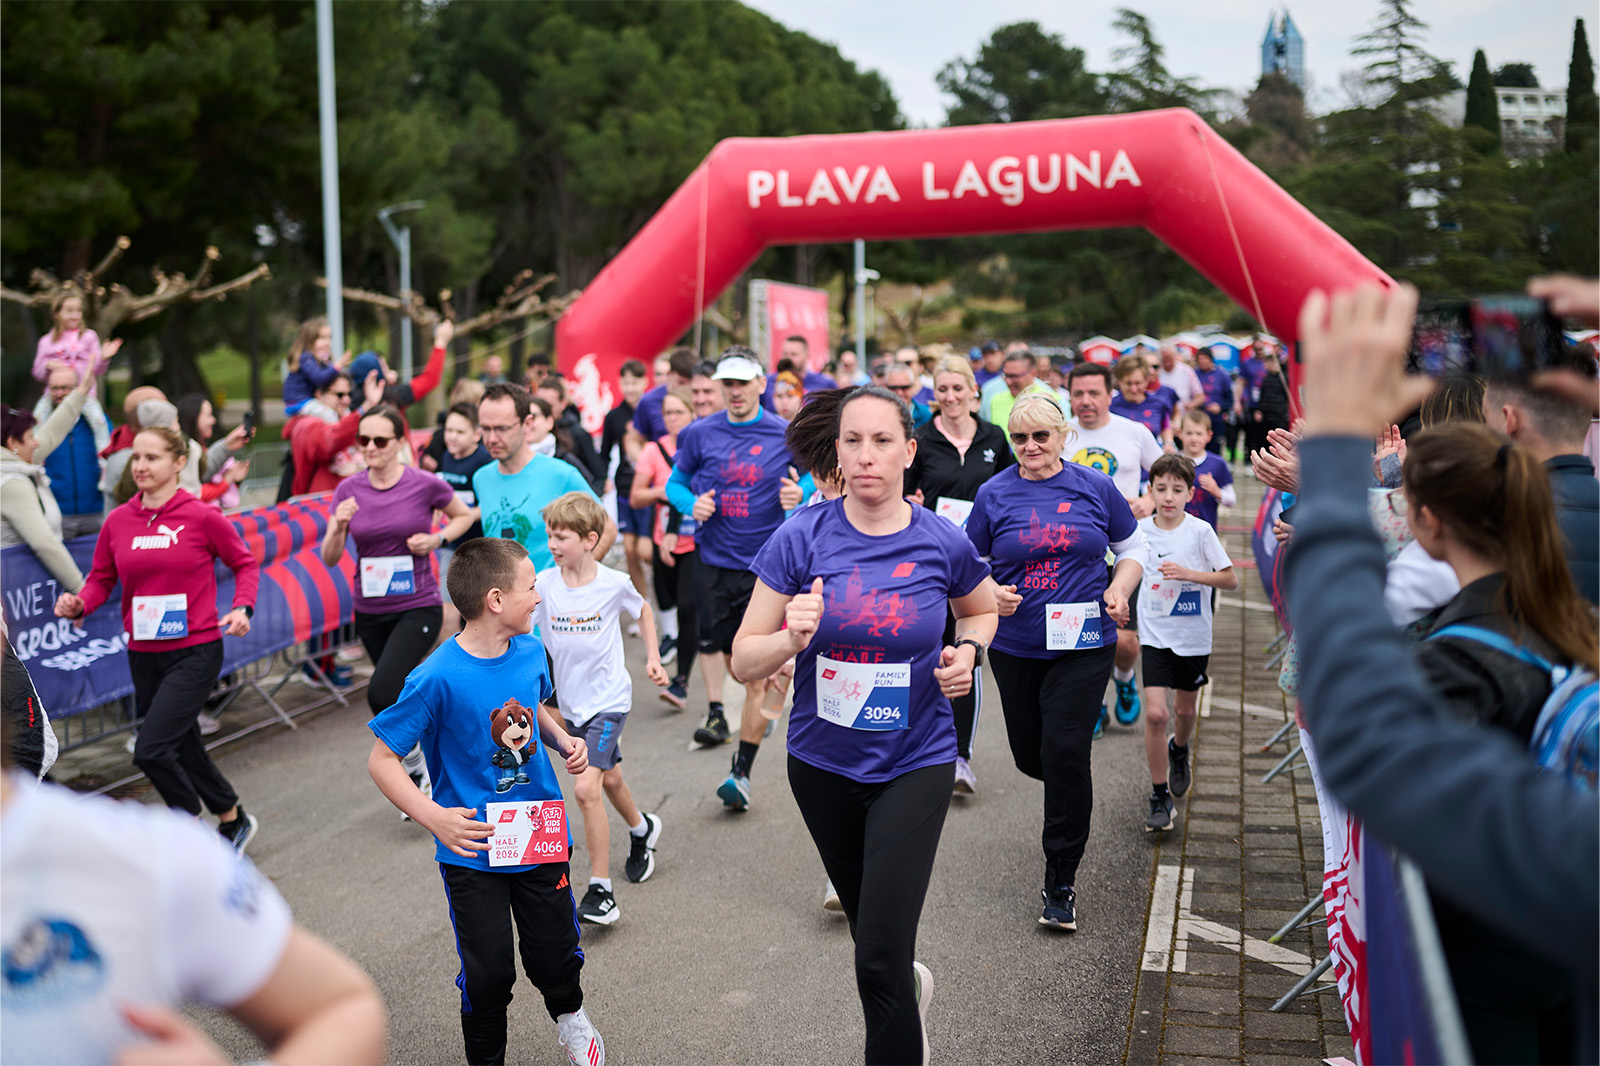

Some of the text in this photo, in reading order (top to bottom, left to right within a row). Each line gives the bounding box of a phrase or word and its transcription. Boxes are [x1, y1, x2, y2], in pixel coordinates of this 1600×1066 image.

[747, 149, 1142, 208] PLAVA LAGUNA
[721, 507, 749, 518] 2026
[131, 535, 171, 550] PUMA
[1025, 561, 1060, 572] HALF
[1024, 576, 1058, 590] 2026
[7, 582, 43, 620] WE
[1177, 602, 1196, 611] 3031
[161, 621, 185, 633] 3096
[551, 624, 601, 632] BASKETBALL
[1081, 631, 1100, 642] 3006
[854, 644, 886, 652] LAGUNA
[831, 649, 885, 664] HALF
[875, 671, 906, 679] FAMILY
[823, 697, 841, 707] HALF
[823, 706, 841, 718] 2026
[864, 706, 901, 720] 3094
[542, 807, 562, 820] PEPI
[545, 826, 560, 834] RUN
[495, 838, 518, 846] HALF
[534, 841, 562, 853] 4066
[496, 849, 518, 859] 2026
